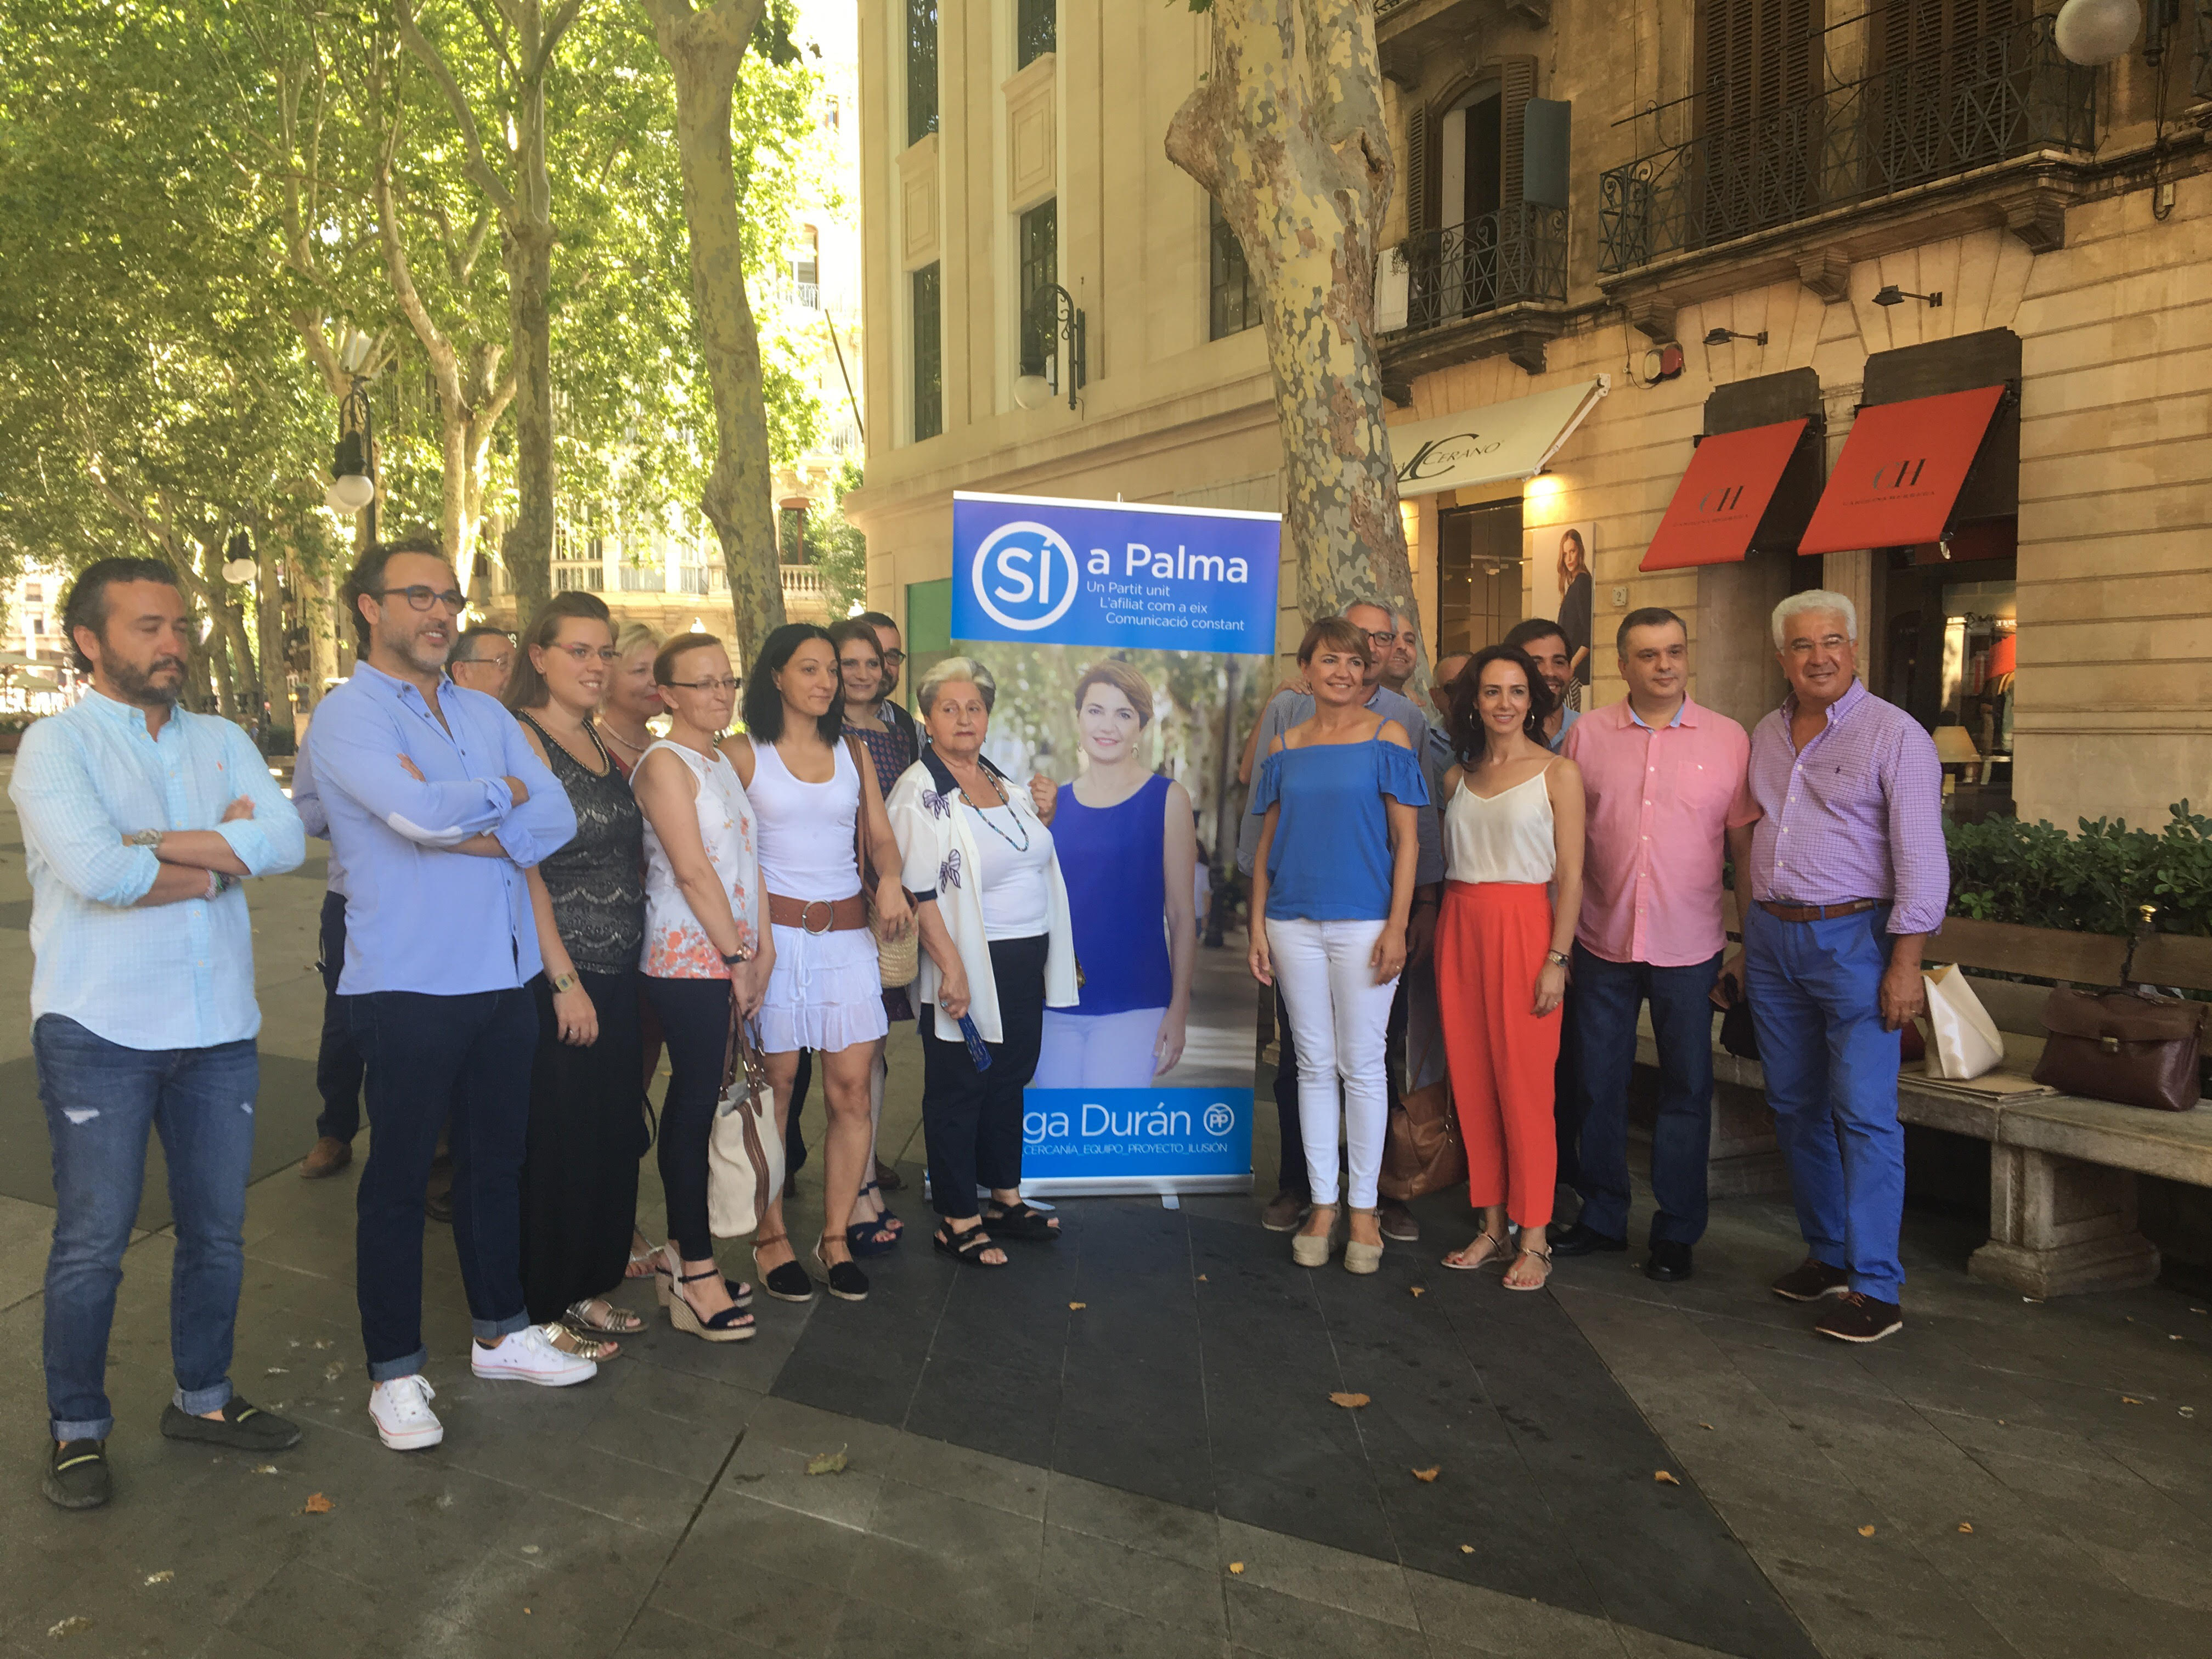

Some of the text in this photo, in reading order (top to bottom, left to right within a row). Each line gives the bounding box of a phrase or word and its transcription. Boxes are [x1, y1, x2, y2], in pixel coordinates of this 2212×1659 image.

[1872, 458, 1927, 490] CH
[1699, 485, 1744, 515] CH
[1087, 548, 1110, 575] a
[1126, 543, 1248, 583] Palma
[1087, 580, 1170, 597] Un Partit unit
[1100, 596, 1207, 614] L'afiliat com a eix
[1105, 612, 1245, 631] Comunicació constant
[1023, 1102, 1191, 1144] ga Durán
